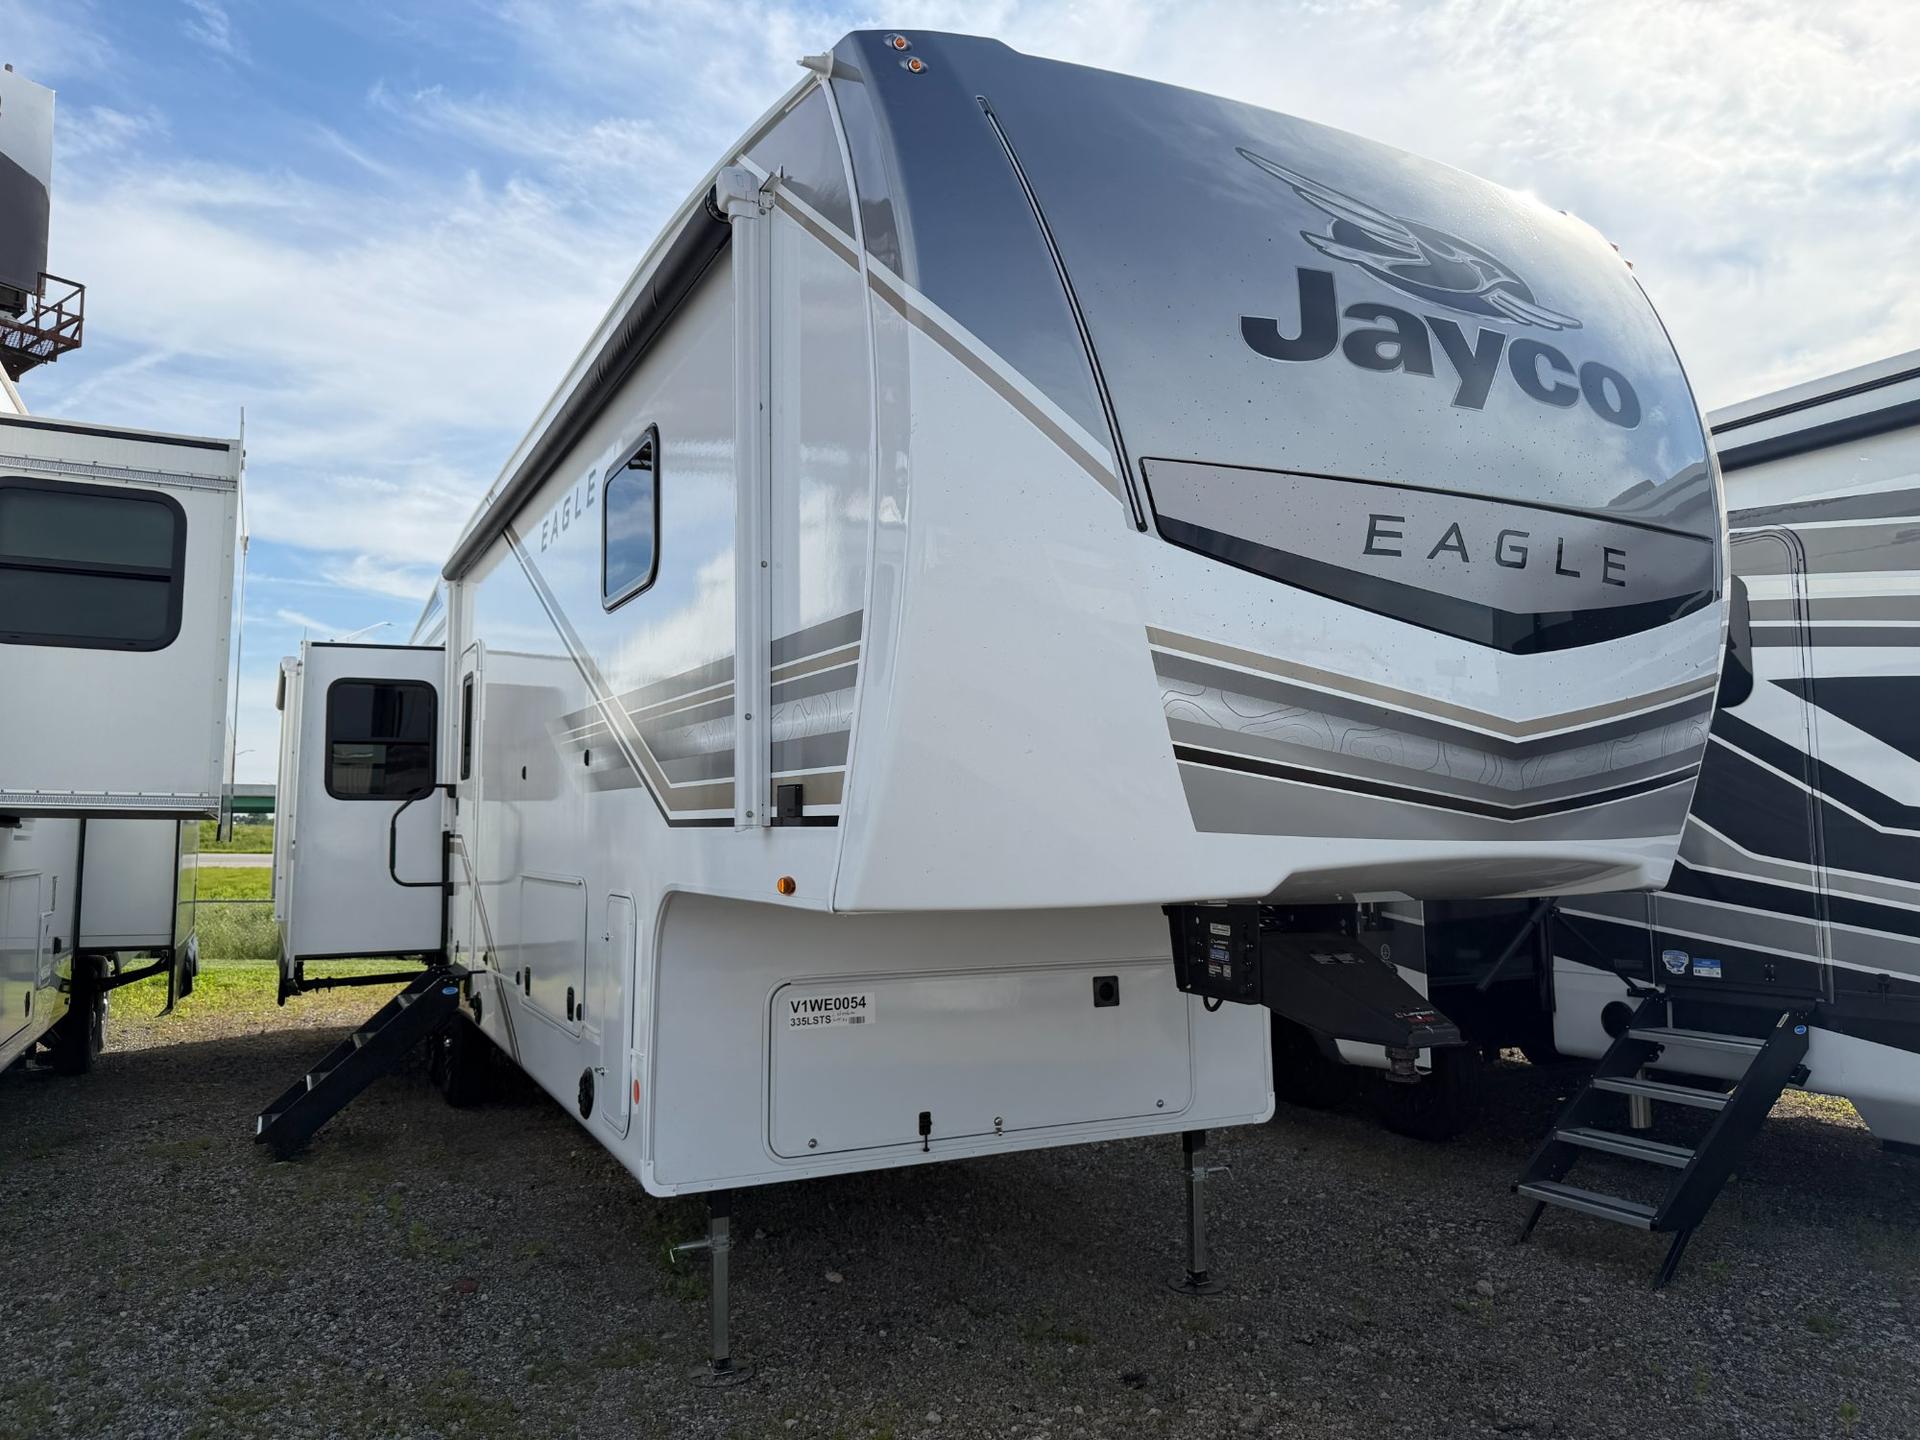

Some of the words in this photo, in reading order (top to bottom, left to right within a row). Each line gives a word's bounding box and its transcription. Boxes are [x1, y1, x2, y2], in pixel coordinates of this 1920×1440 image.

[1239, 266, 1642, 430] Jayco
[541, 468, 597, 553] EAGLE
[1362, 513, 1627, 587] EAGLE
[790, 995, 867, 1014] V1WE0054
[790, 1014, 832, 1027] 335LSTS
